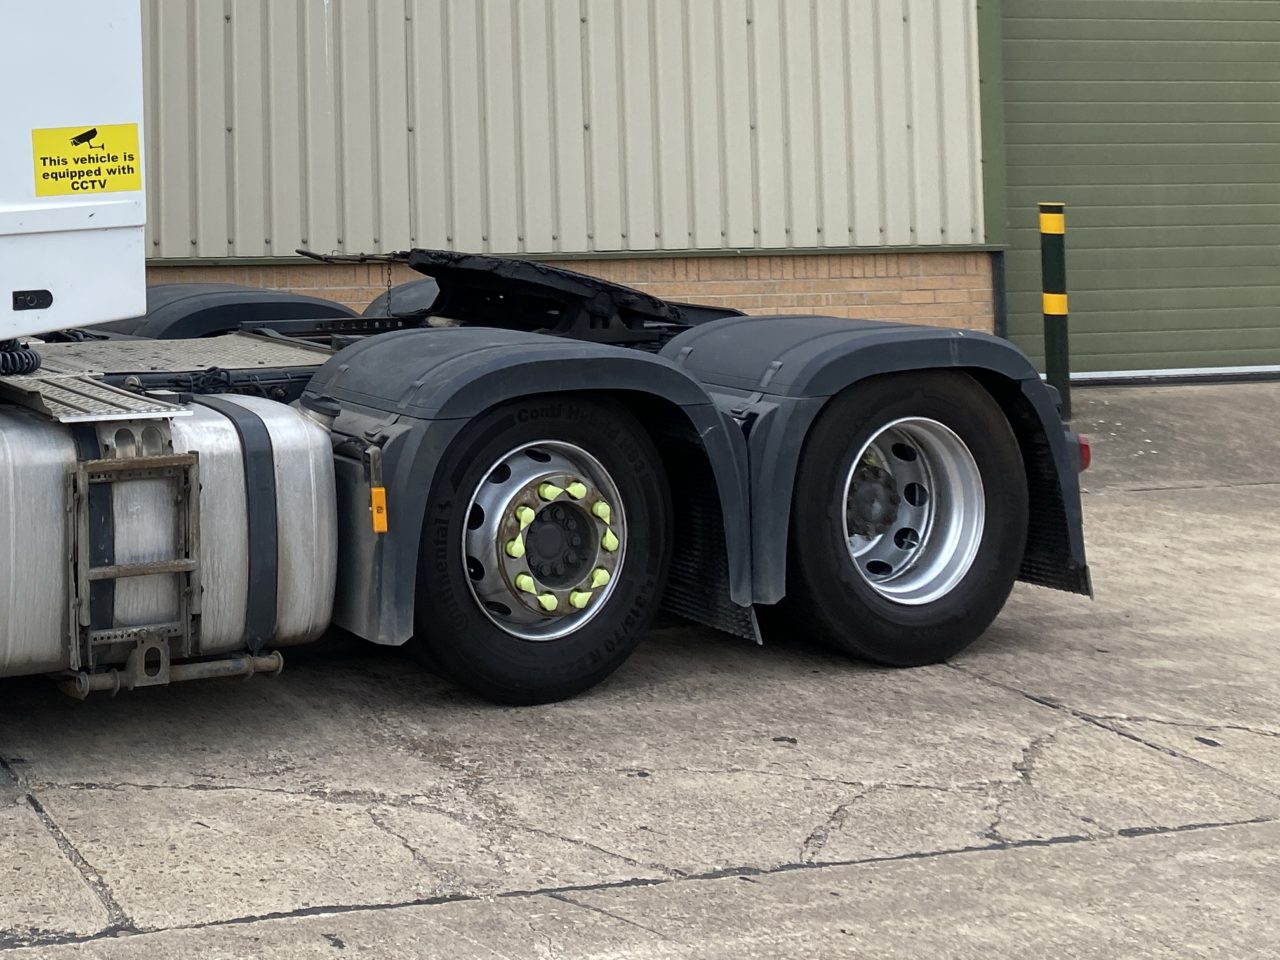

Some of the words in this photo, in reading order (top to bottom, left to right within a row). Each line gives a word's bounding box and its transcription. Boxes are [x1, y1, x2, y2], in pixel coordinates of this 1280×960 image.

[40, 155, 68, 166] This
[73, 153, 119, 165] vehicle
[123, 152, 135, 161] is
[42, 166, 101, 181] equipped
[106, 165, 135, 176] with
[71, 179, 107, 191] CCTV
